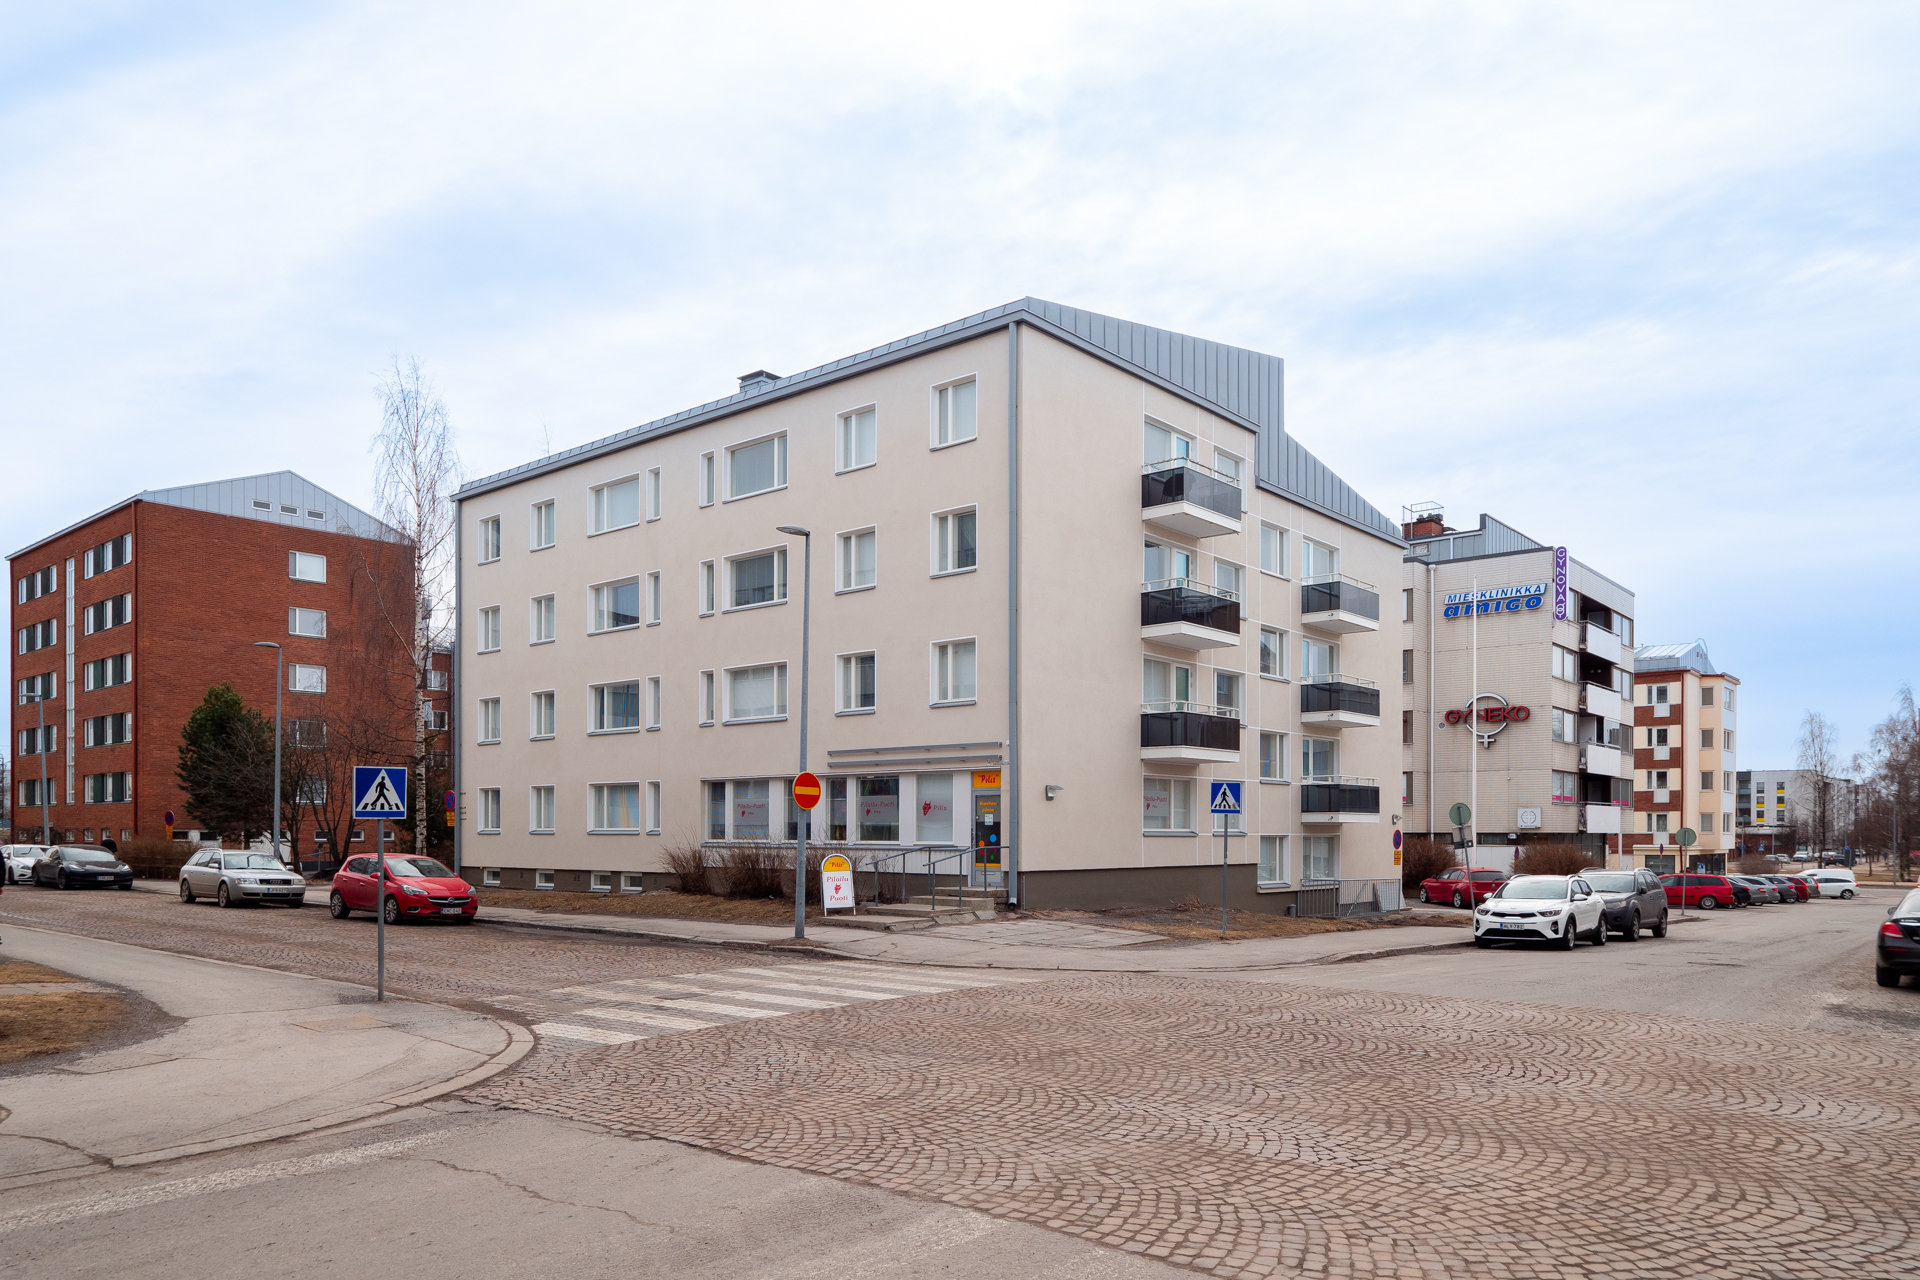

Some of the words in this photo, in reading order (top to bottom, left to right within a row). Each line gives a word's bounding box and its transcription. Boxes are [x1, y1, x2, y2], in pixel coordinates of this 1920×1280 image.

[1556, 548, 1566, 602] GYNOVA
[1448, 585, 1541, 603] MIESKLINIKKA
[1444, 706, 1530, 724] GYNEKO
